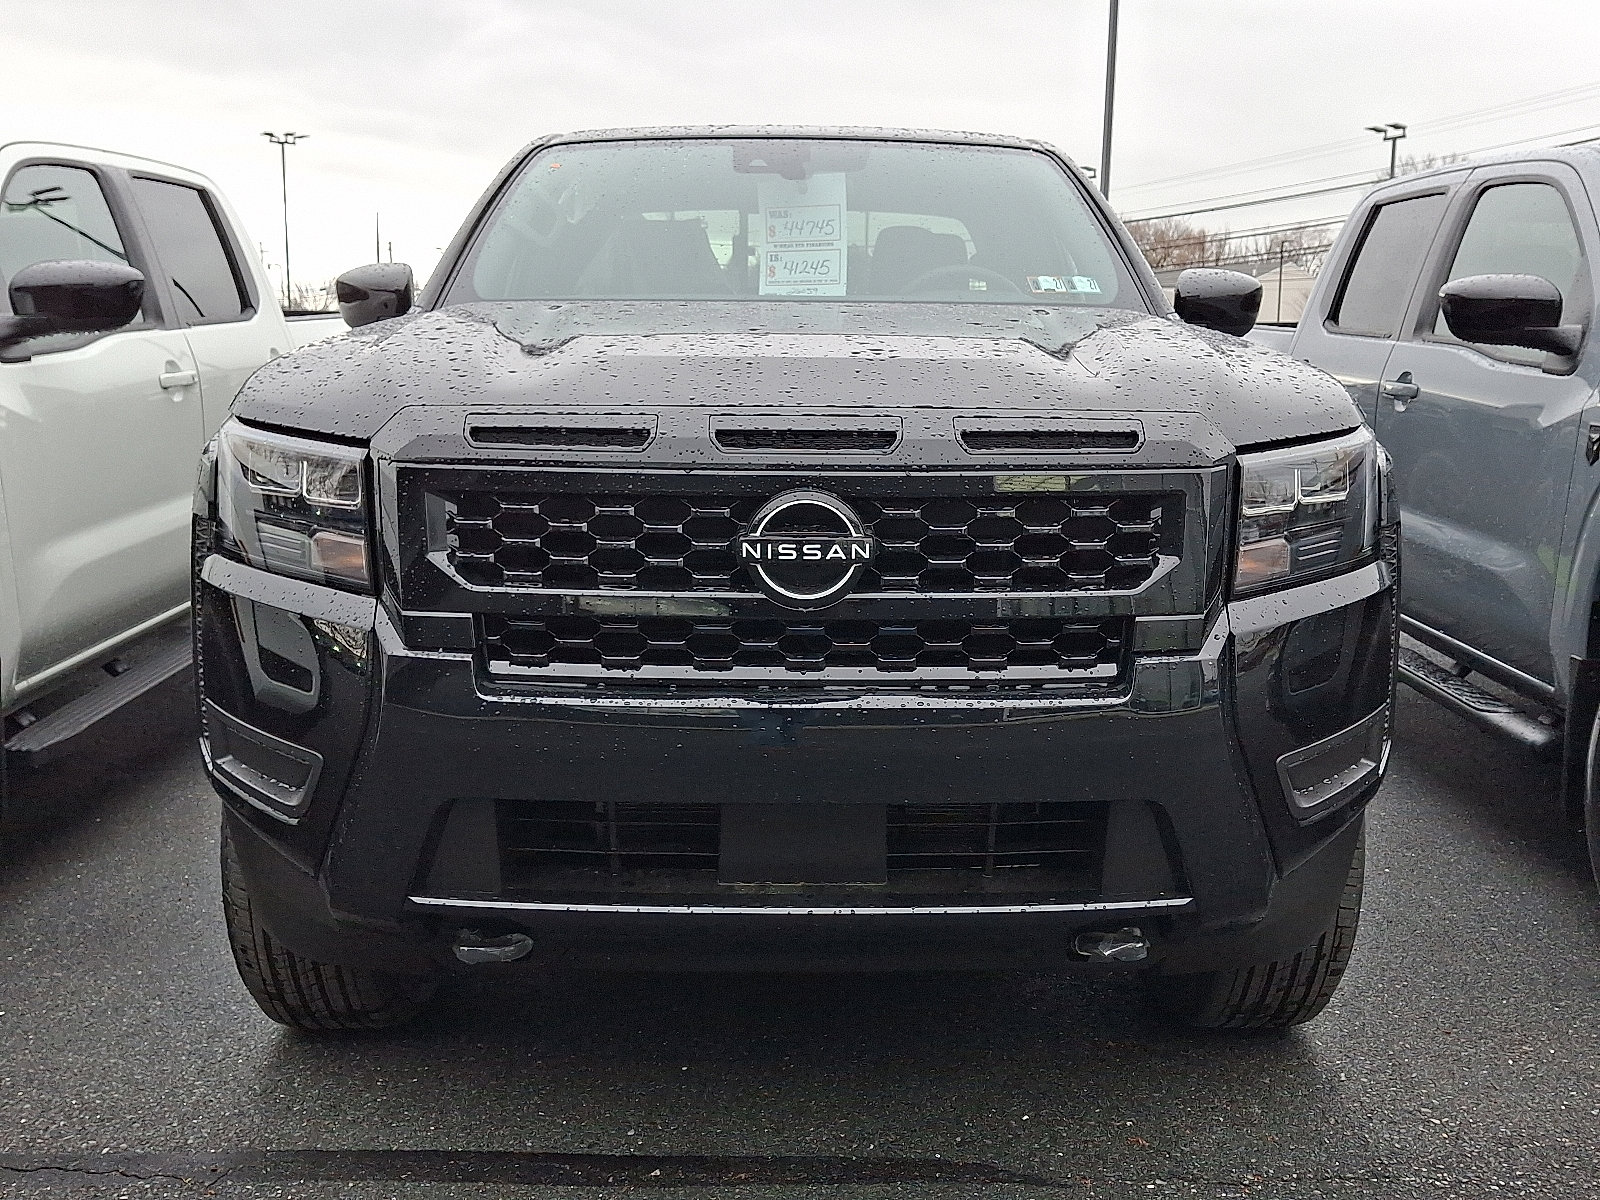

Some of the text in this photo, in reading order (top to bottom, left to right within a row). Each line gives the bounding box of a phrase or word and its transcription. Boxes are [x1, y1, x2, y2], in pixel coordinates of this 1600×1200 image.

[783, 218, 835, 237] 44745
[769, 254, 783, 263] IS:
[783, 259, 831, 276] 41245
[741, 542, 870, 560] NISSAN
